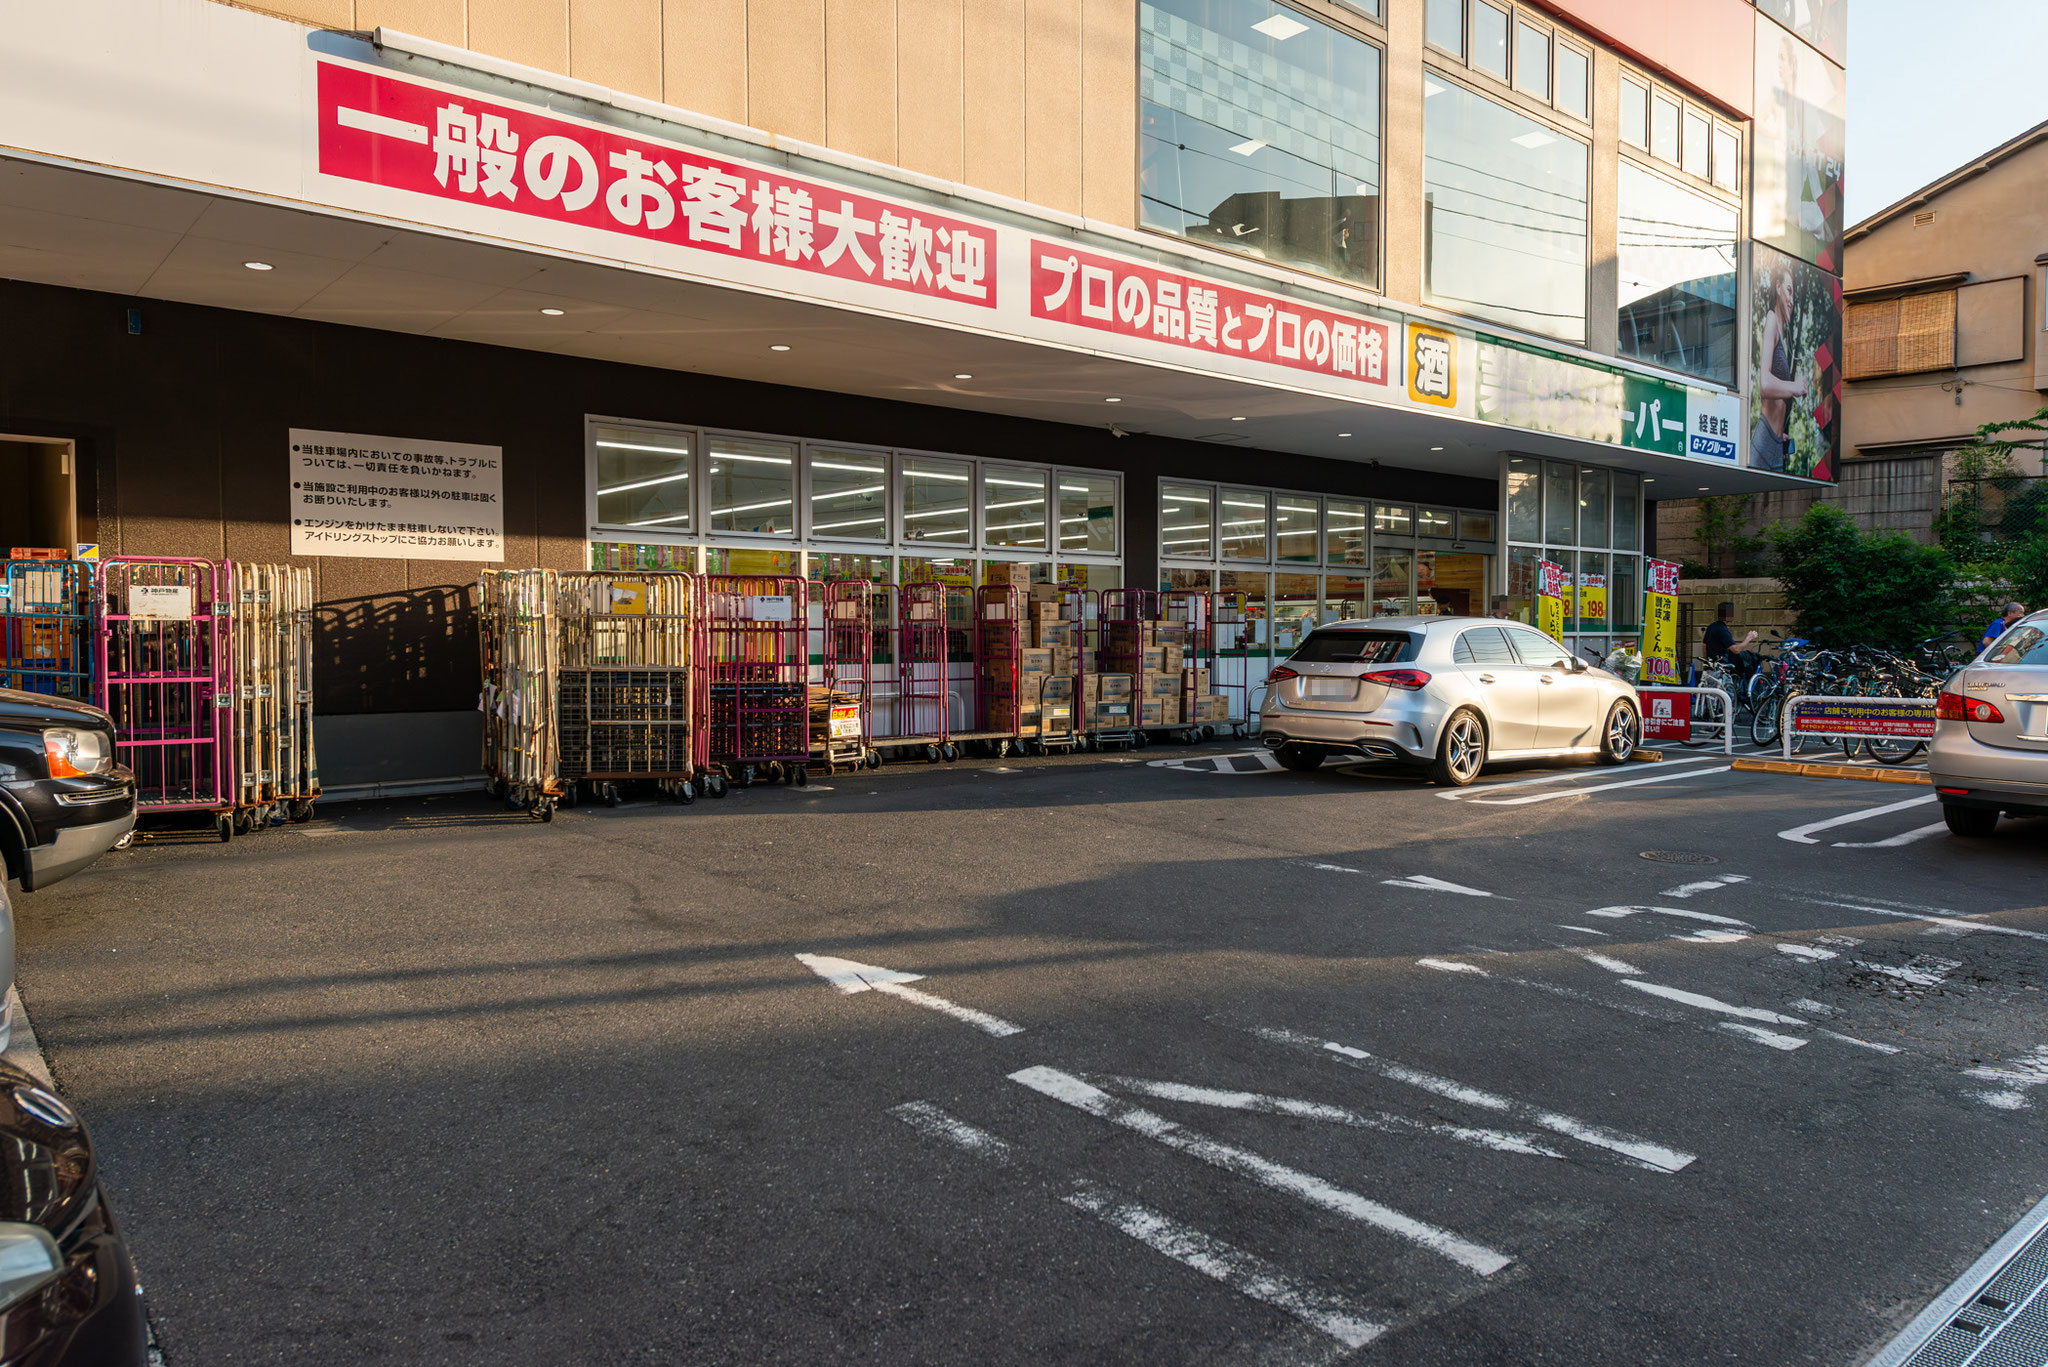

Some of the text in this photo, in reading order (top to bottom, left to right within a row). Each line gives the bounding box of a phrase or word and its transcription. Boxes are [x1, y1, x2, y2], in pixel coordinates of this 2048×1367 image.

[337, 103, 988, 300] 一般のお客様大歓迎
[1040, 254, 1383, 381] プロの品質とプロの価格
[1415, 332, 1450, 399] 酒
[1698, 412, 1729, 438] 経堂店
[302, 444, 497, 469] 当駐車場内においての事故等、トラブルに
[302, 457, 477, 479] ついては、一切責任を負いかねます。
[303, 481, 497, 503] 当施設ご利用中のお客様以外の駐車は固く
[303, 494, 392, 509] お断りいたします。
[304, 518, 500, 537] エンジンをかけたまま駐車しないで下さい。
[305, 531, 500, 549] アイドリングストップにご協力お願いします。
[1587, 600, 1604, 617] 198
[1646, 657, 1671, 677] 100
